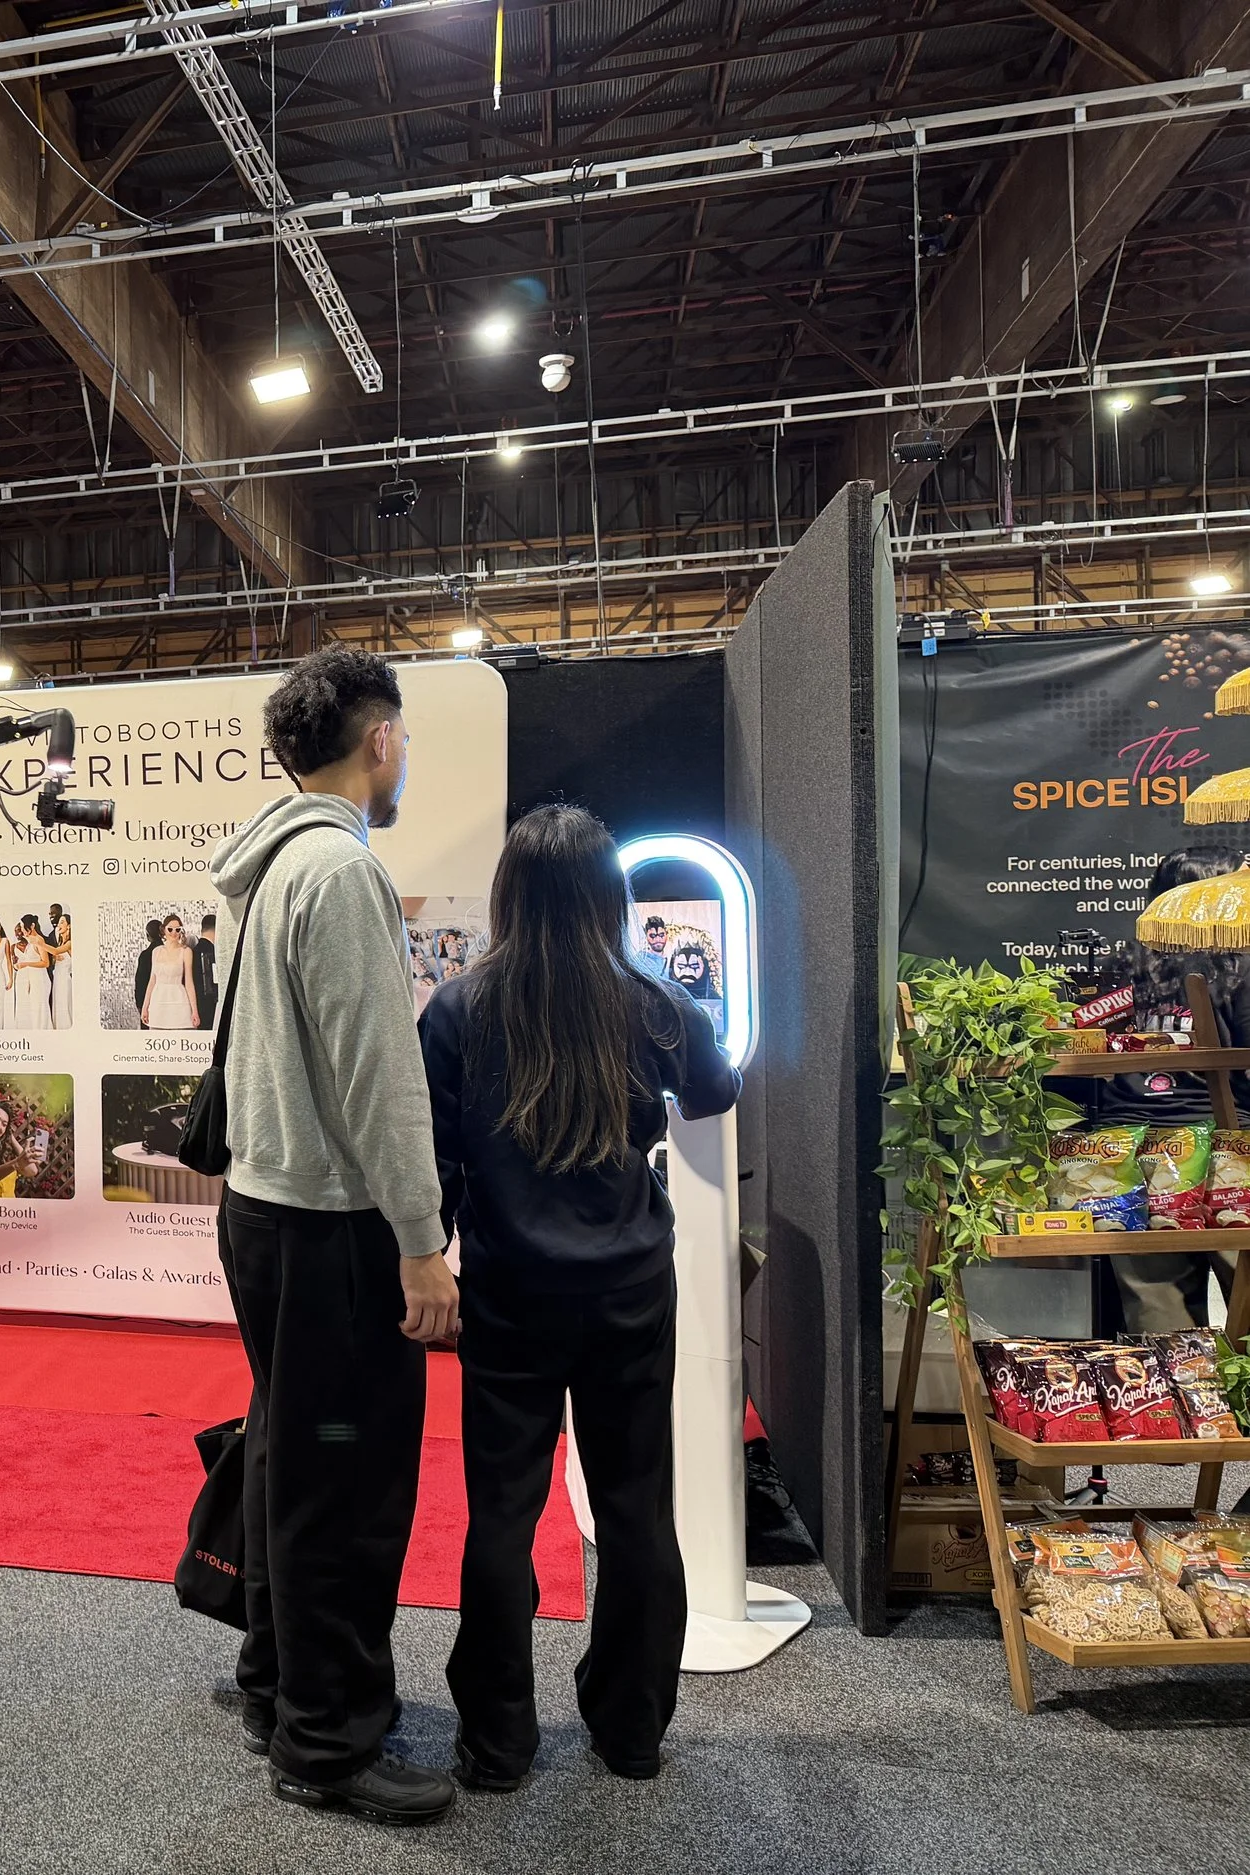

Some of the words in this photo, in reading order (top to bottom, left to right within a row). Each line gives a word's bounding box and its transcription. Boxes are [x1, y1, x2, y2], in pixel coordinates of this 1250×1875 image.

[27, 717, 242, 746] VITOBOOTHS
[1117, 726, 1210, 786] The
[1012, 777, 1130, 810] SPICE
[1140, 775, 1189, 806] ISL
[11, 824, 101, 844] Modern
[125, 820, 242, 848] Unforgett
[1007, 856, 1036, 871] For
[1039, 854, 1126, 871] centuries,
[986, 876, 1080, 893] connected
[1083, 876, 1114, 891] the
[1117, 875, 1152, 890] wor
[1076, 898, 1109, 912] and
[1114, 896, 1145, 912] culi
[1002, 942, 1057, 958] Today,
[1077, 989, 1133, 1023] KOPIKO
[144, 1038, 176, 1051] 360°
[113, 1054, 157, 1063] Cinematic,
[159, 1054, 210, 1064] Share-Stopp
[1149, 1197, 1175, 1206] ALADO
[1212, 1191, 1244, 1201] BALADO
[0, 1206, 36, 1219] Booth
[125, 1211, 165, 1224] Audio
[169, 1212, 211, 1227] Guest
[11, 1222, 38, 1230] Device
[129, 1226, 144, 1235] The
[146, 1228, 170, 1236] Guest
[172, 1229, 194, 1237] Book
[196, 1230, 215, 1238] That
[26, 1261, 78, 1278] Parties
[92, 1264, 137, 1281] Galas
[142, 1267, 155, 1282] &
[160, 1269, 222, 1286] Awards
[1035, 1386, 1075, 1414] Kapal
[1107, 1381, 1150, 1411] Kapal
[195, 1550, 237, 1577] STOLEN
